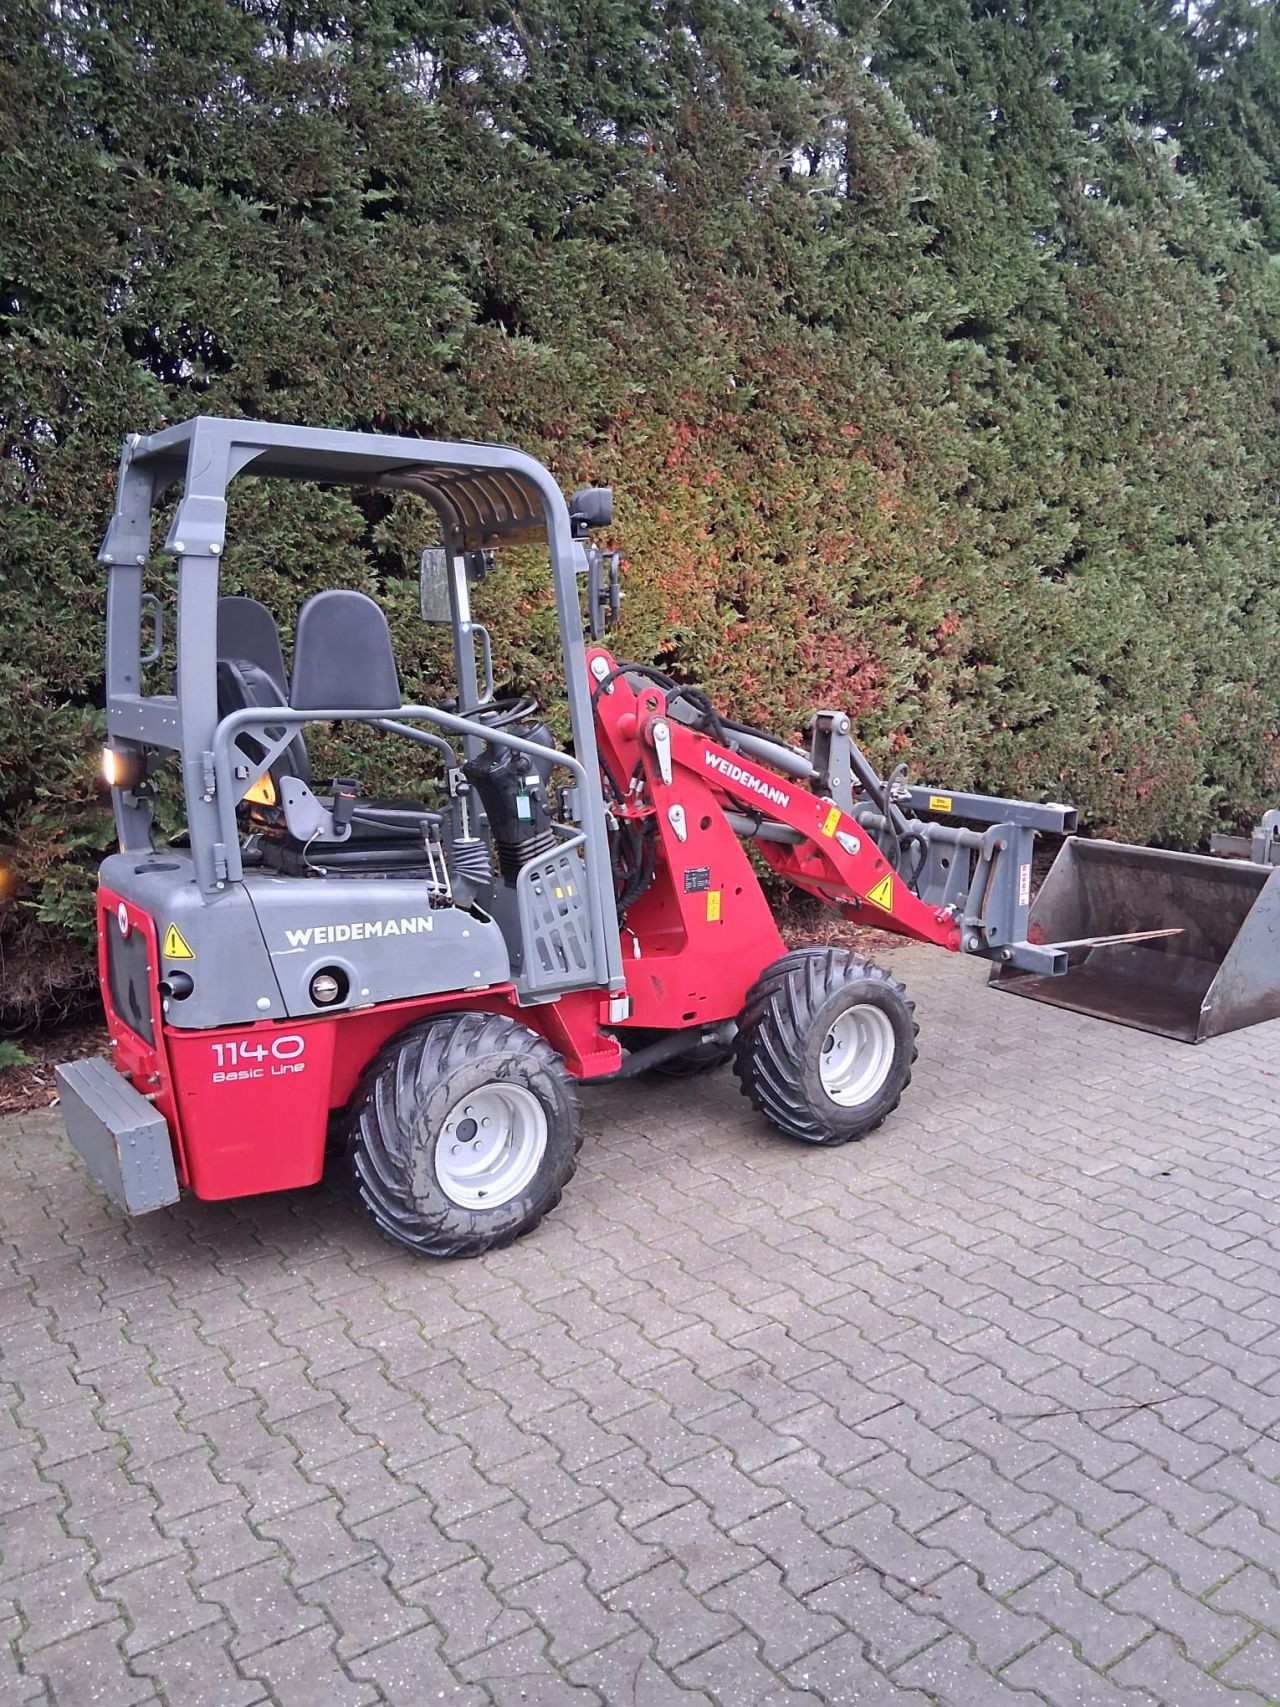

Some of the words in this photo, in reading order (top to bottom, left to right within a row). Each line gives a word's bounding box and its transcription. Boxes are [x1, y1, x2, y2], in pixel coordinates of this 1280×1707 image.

[705, 750, 790, 808] WEIDEMANN
[285, 916, 433, 947] WEIDEMANN
[211, 1035, 305, 1067] 1140
[212, 1068, 264, 1083] Basic
[271, 1062, 305, 1075] Line
